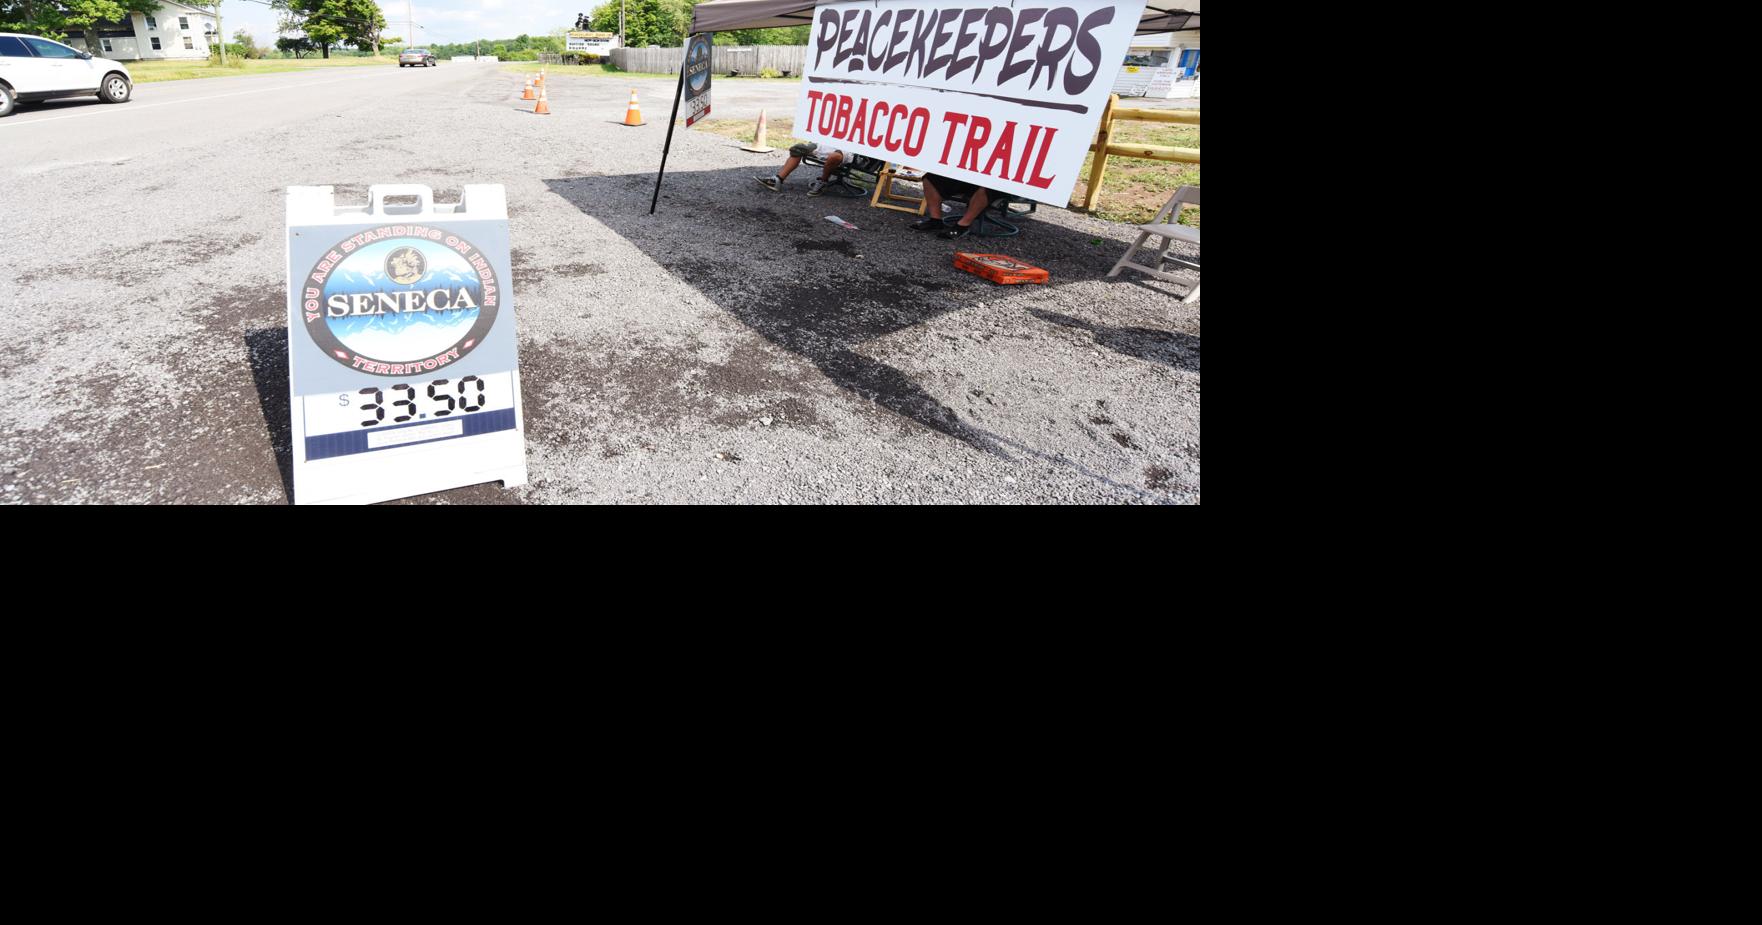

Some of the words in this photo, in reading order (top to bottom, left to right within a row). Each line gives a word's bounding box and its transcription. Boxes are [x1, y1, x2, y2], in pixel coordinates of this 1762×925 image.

[814, 5, 1116, 96] PEACEKEEPERS
[806, 90, 931, 157] TOBACCO
[938, 111, 1059, 190] TRAIL
[342, 225, 442, 254] STANDING
[445, 235, 471, 252] ON
[311, 250, 342, 284] ARE
[470, 254, 496, 306] INDIAN
[306, 287, 321, 323] YOU
[327, 287, 477, 317] SENECA
[353, 347, 461, 375] TERRITORY
